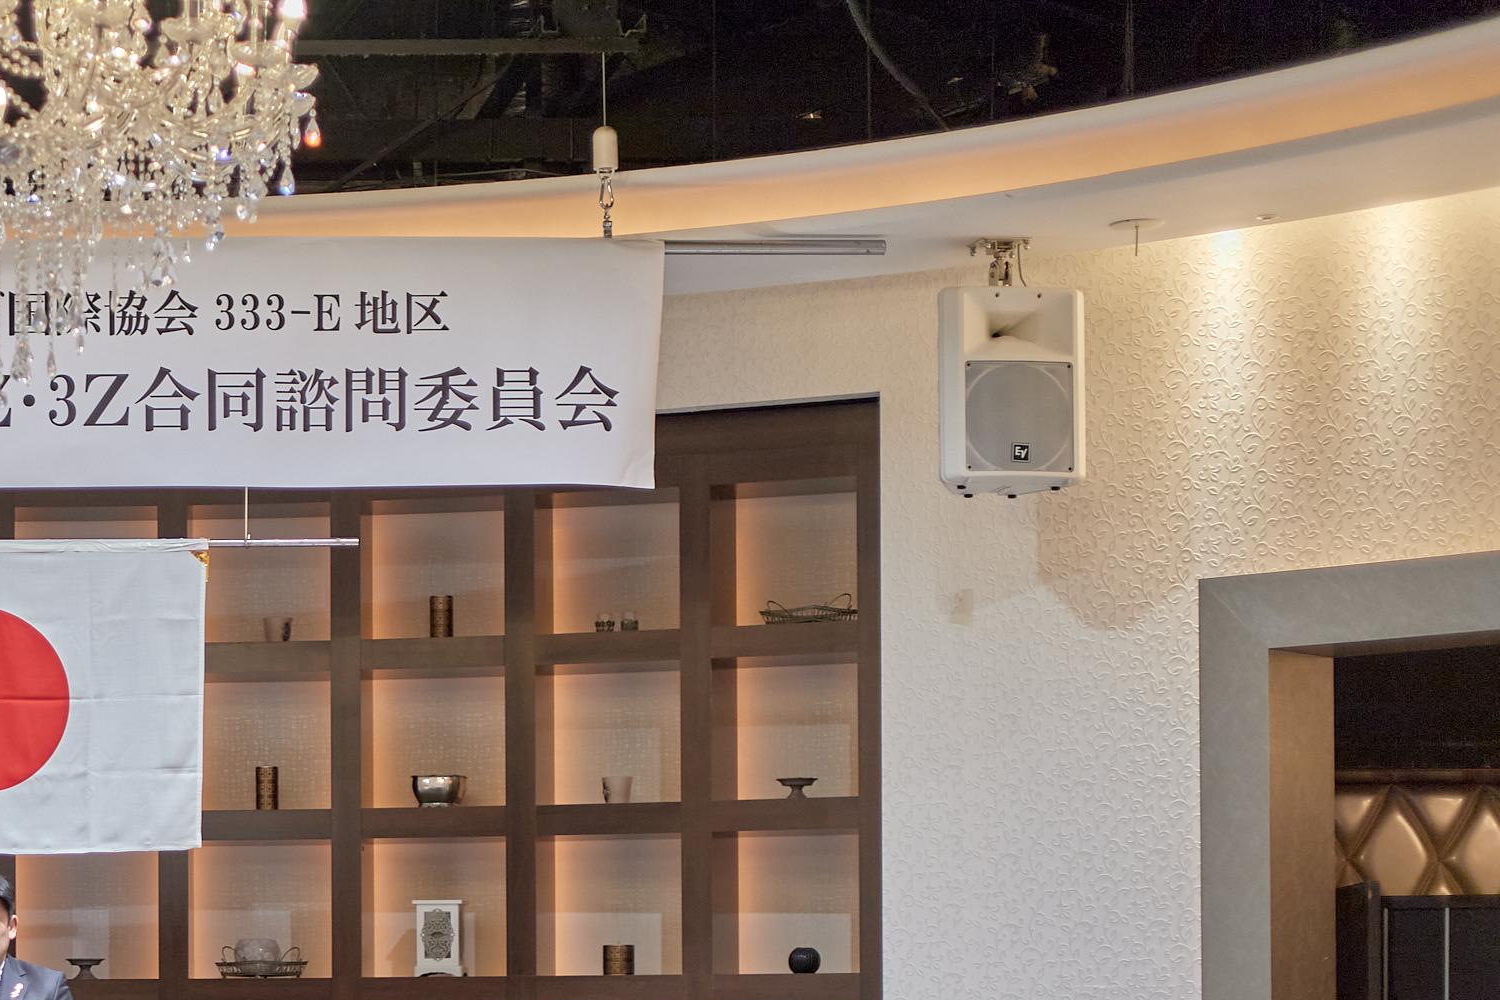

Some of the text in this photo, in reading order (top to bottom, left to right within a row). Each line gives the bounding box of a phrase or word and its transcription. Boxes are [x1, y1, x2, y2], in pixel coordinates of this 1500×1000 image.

[214, 292, 342, 333] 333-E
[353, 289, 451, 336] 地区
[1014, 446, 1028, 459] EV
